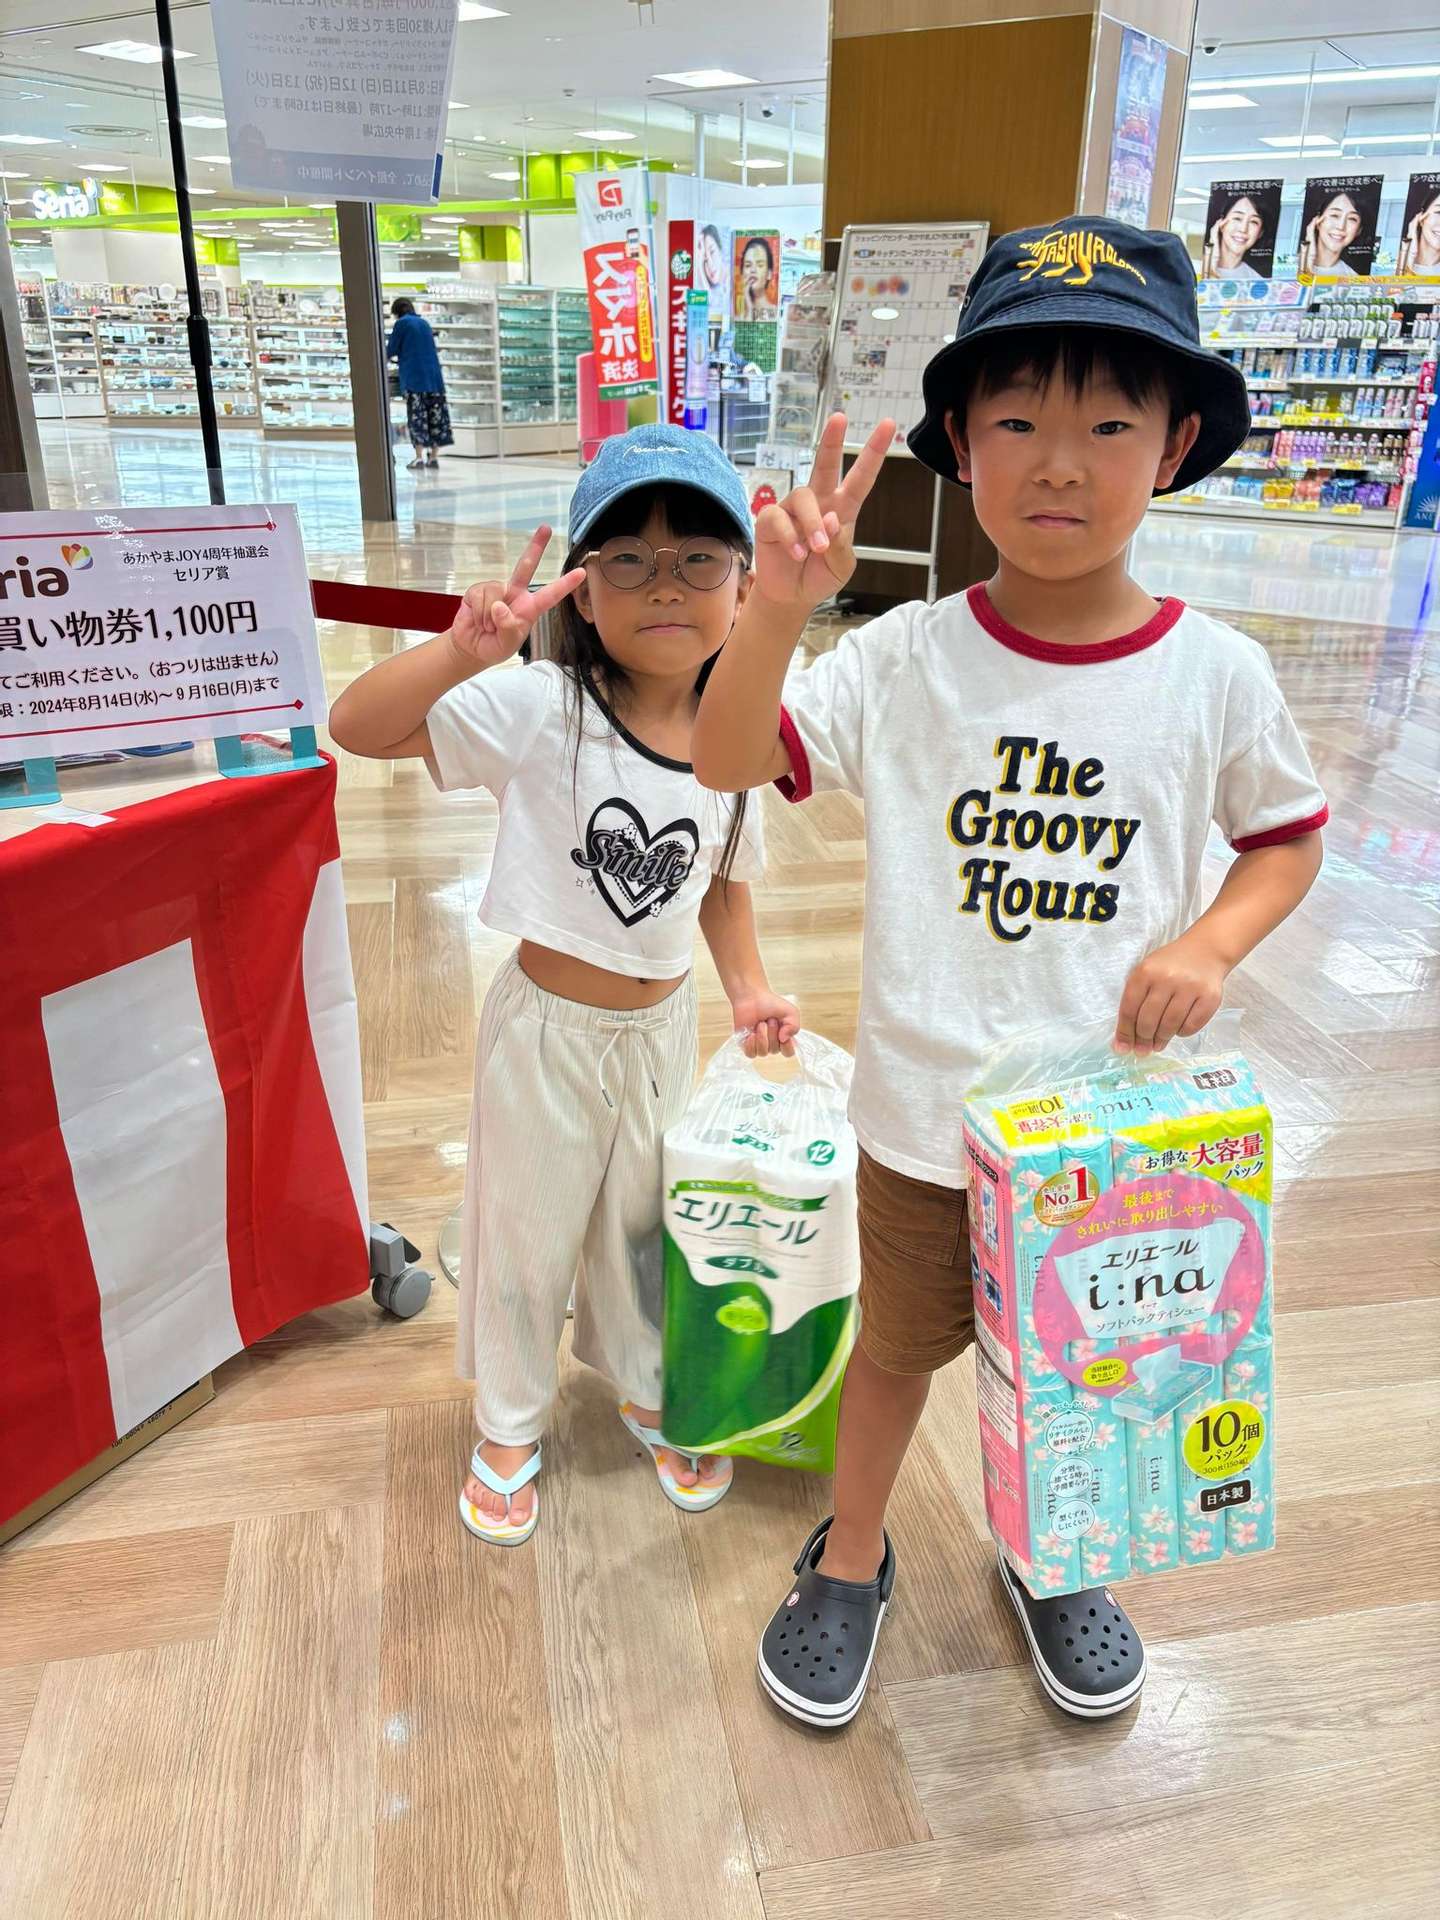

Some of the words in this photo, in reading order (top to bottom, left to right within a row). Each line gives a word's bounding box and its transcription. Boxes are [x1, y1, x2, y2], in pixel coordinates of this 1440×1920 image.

[32, 185, 90, 220] Seria
[122, 545, 270, 565] あかやまJOY4周年抽選会
[173, 565, 231, 582] セリア賞
[993, 735, 1105, 799] The
[946, 789, 1142, 872] Groovy
[570, 828, 690, 892] Smile
[958, 857, 1121, 944] Hours
[808, 1143, 831, 1164] 12
[1224, 1161, 1264, 1180] パック
[1122, 1189, 1176, 1209] 最後まで
[673, 1197, 821, 1245] エリエール
[1076, 1202, 1224, 1240] きれいに取り出しやすい
[1100, 1239, 1200, 1270] エリエール
[1089, 1265, 1216, 1311] i:na
[1195, 1410, 1260, 1453] 10個
[1204, 1443, 1248, 1465] パック
[1207, 1485, 1245, 1506] 日本製
